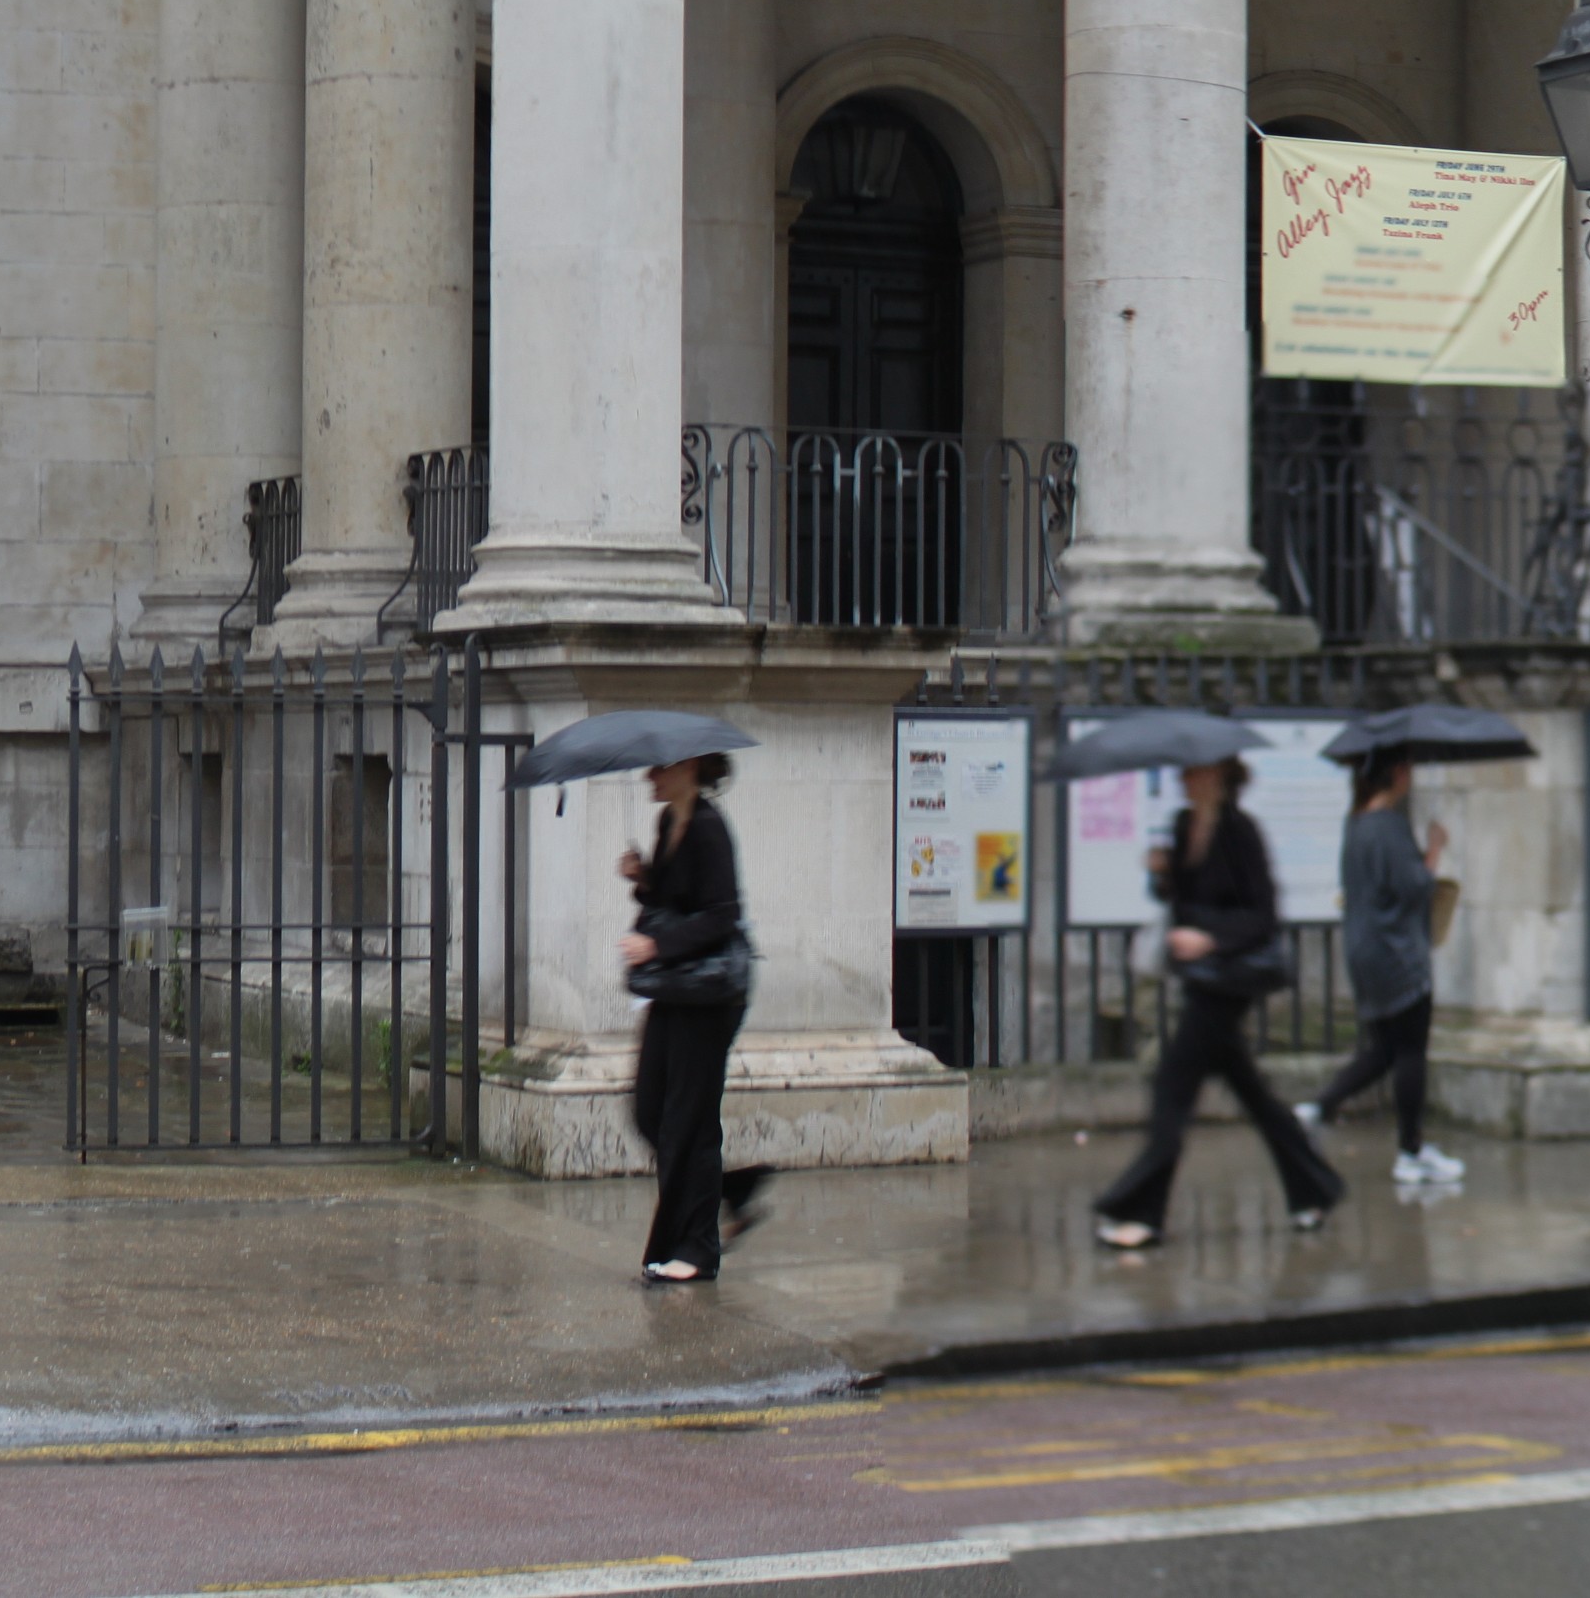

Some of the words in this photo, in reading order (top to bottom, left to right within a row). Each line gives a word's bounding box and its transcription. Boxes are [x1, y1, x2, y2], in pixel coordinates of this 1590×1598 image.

[1436, 161, 1463, 170] FRIDAY
[1465, 163, 1484, 172] JUNE
[1283, 164, 1316, 205] Gin
[1434, 172, 1455, 181] Tina
[1458, 174, 1476, 184] May
[1491, 176, 1517, 185] Nikki
[1325, 166, 1370, 214] Jazz
[1409, 189, 1436, 198] FRIDAY
[1437, 191, 1455, 200] JULY
[1409, 201, 1437, 211] Aleph
[1440, 203, 1459, 212] Trio
[1383, 217, 1410, 226] FRIDAY
[1411, 219, 1429, 227] JULY
[1278, 208, 1330, 258] Alley
